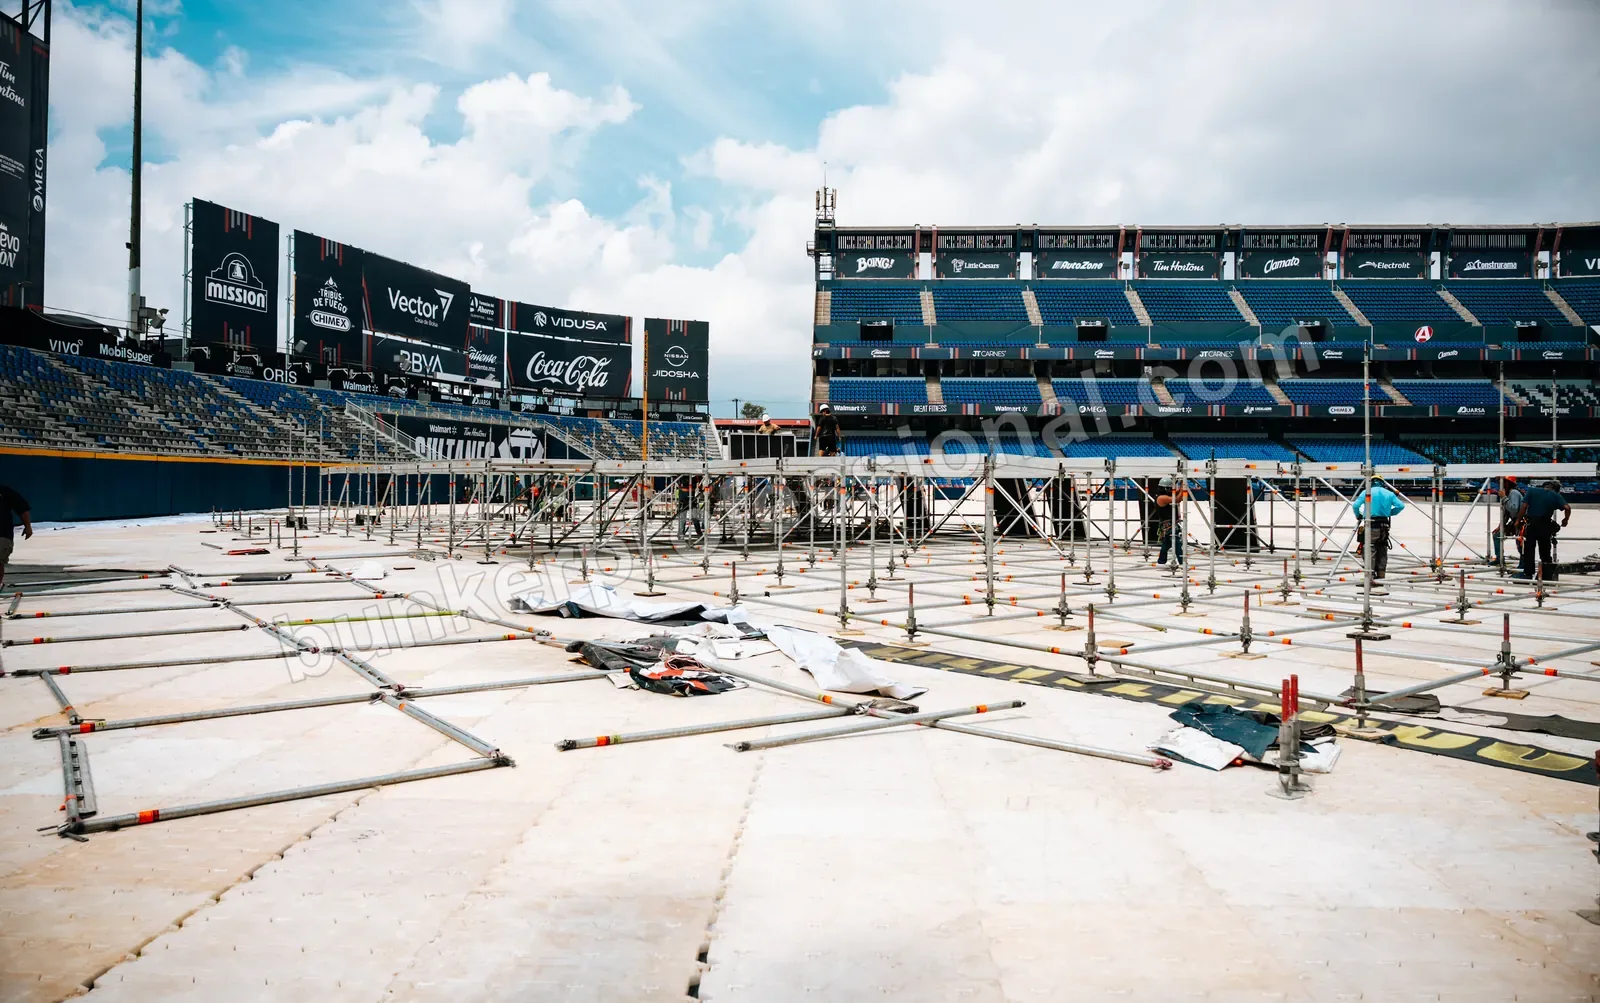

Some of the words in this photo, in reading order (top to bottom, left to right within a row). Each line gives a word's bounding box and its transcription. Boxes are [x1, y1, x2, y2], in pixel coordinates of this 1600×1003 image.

[0, 86, 25, 106] rtons
[1153, 260, 1170, 271] Tim
[1170, 261, 1205, 271] Hortons
[1264, 256, 1300, 274] Clamato
[320, 288, 342, 302] TRIBUS
[313, 298, 323, 307] DE
[324, 298, 348, 314] FUEGO
[387, 286, 439, 320] Vector
[313, 313, 347, 328] CHIMEX
[550, 316, 607, 331] VIDUSA
[263, 367, 298, 384] ORIS
[526, 350, 612, 392] Coca-Cola
[652, 370, 699, 379] JIDOSHA
[343, 380, 372, 393] Walmart
[430, 424, 451, 434] Walmart
